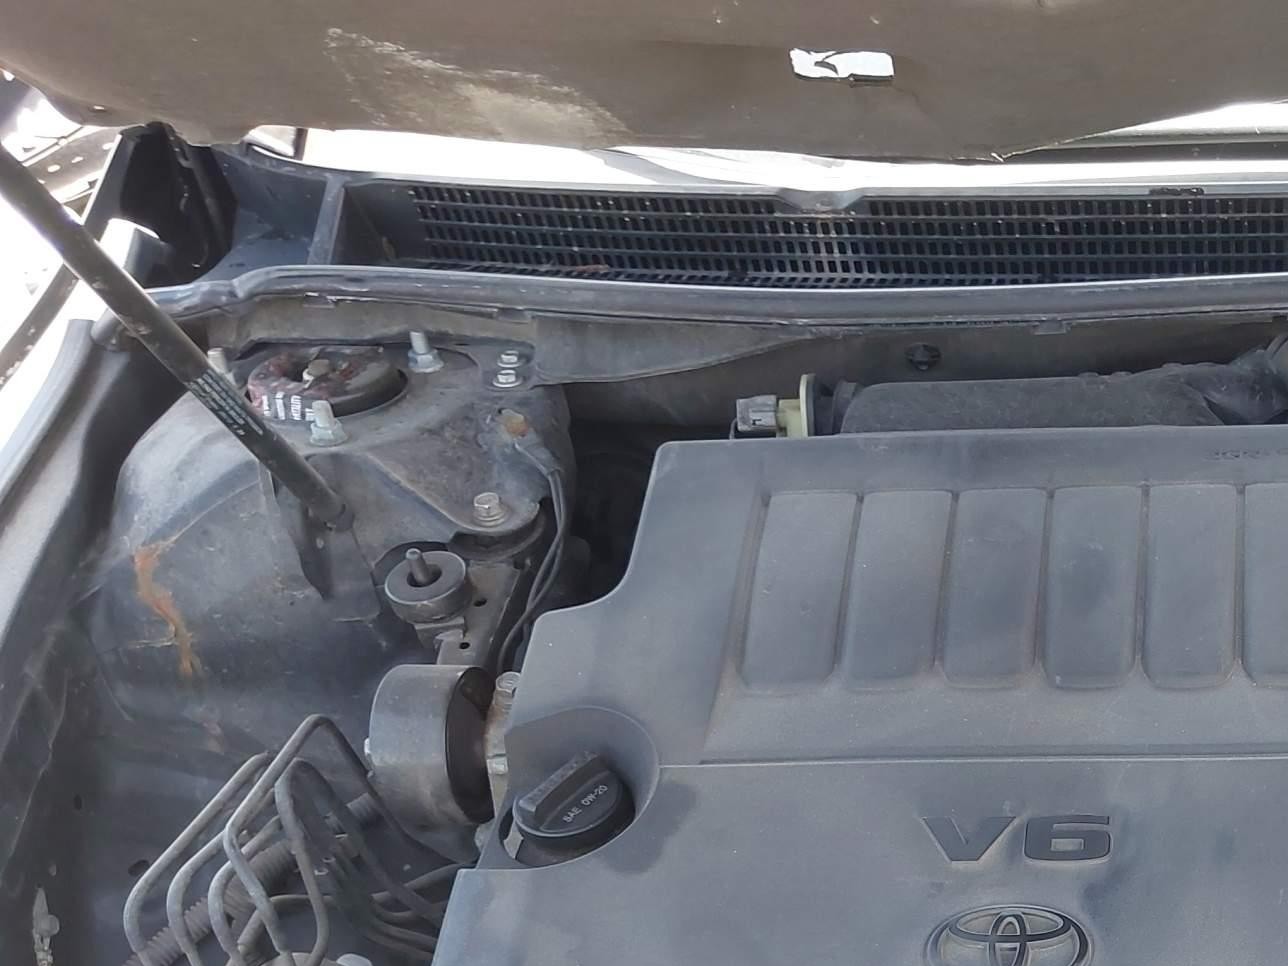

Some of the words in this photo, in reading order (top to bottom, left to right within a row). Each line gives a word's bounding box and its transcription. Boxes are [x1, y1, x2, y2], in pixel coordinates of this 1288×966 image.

[562, 806, 582, 823] SAE
[581, 785, 608, 806] 0W-20
[921, 813, 1112, 862] V6
